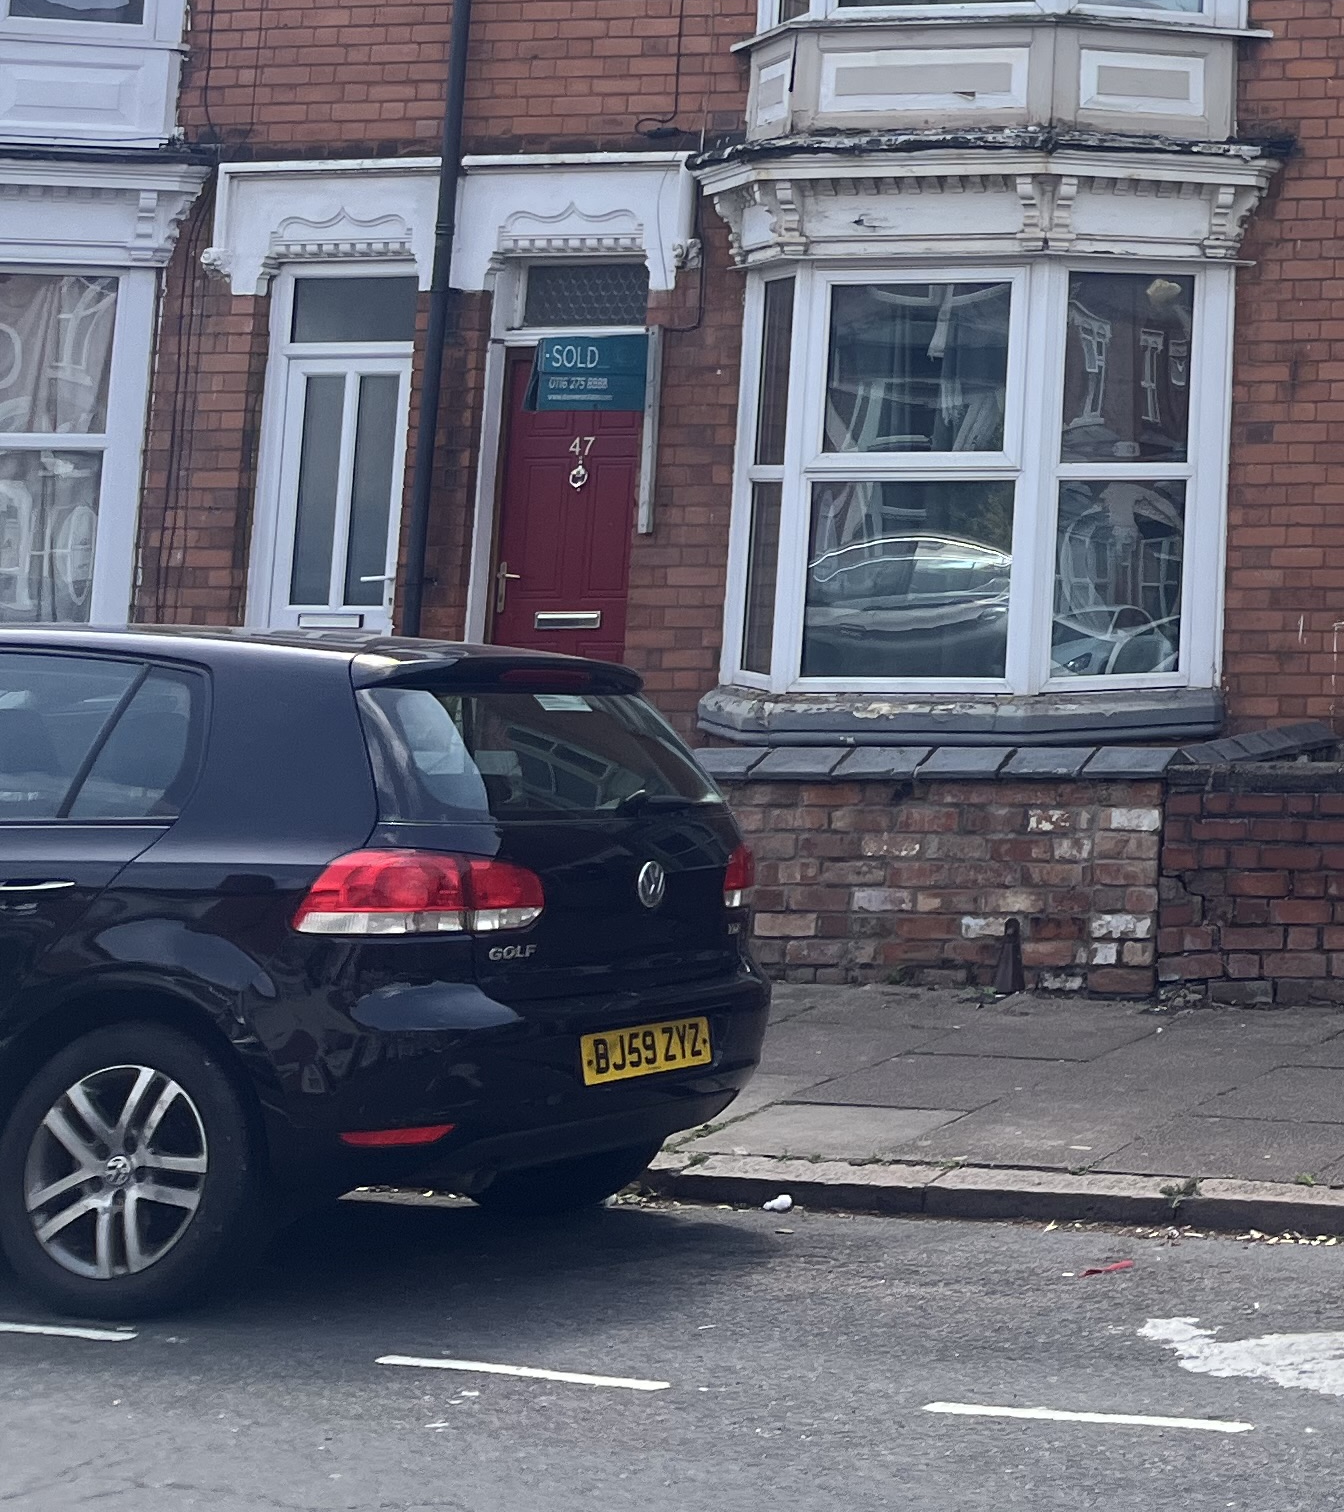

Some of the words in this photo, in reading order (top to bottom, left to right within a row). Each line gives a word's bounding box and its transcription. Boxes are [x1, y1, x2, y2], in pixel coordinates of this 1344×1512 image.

[552, 345, 599, 368] SOLD
[568, 436, 596, 456] 47
[488, 944, 538, 961] GOLF
[593, 1030, 658, 1076] BJ59
[661, 1023, 703, 1062] ZYZ
